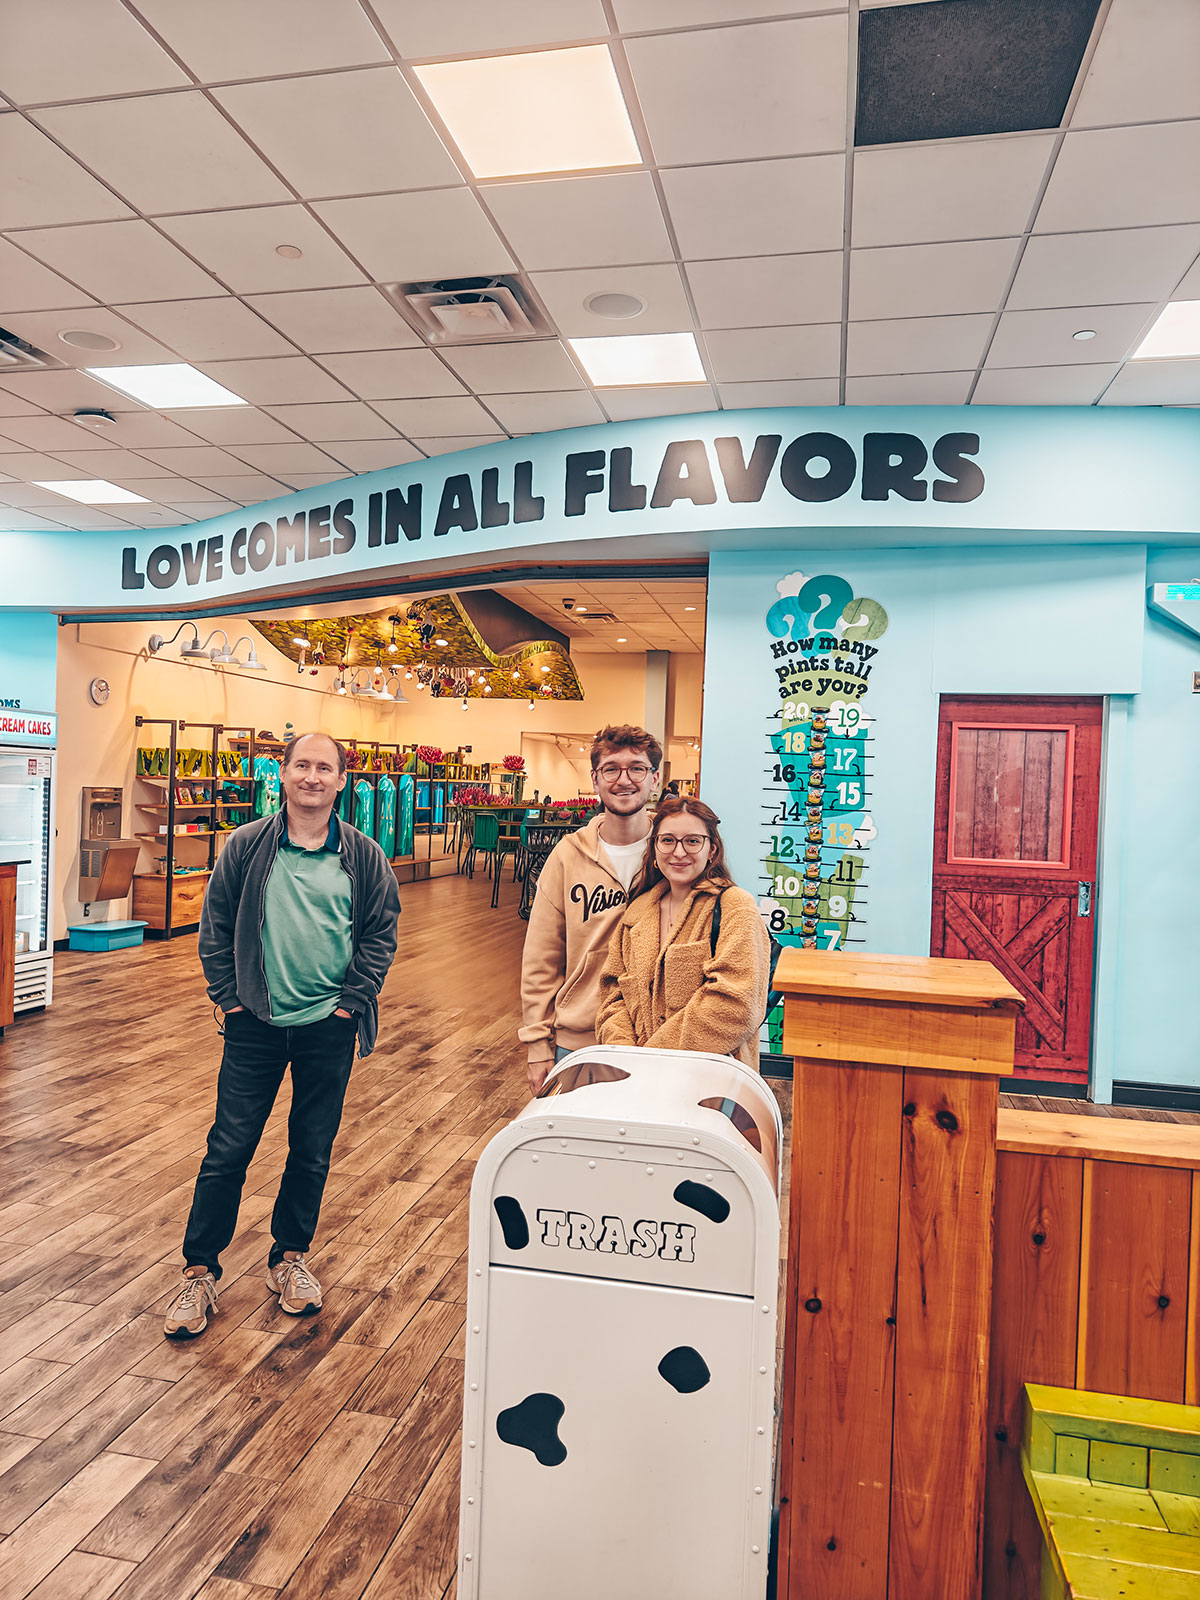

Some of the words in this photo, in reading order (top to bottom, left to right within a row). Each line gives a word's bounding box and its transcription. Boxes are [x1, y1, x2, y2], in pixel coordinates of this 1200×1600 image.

[121, 534, 224, 590] LOVE
[230, 498, 357, 576] COMES
[367, 482, 423, 549] IN
[433, 460, 546, 537] ALL
[563, 431, 986, 518] FLAVORS
[769, 637, 815, 659] How
[818, 636, 879, 661] many
[775, 655, 829, 684] pints
[834, 656, 872, 681] tall
[778, 678, 813, 699] are
[815, 677, 868, 699] you?
[783, 701, 810, 719] 20
[837, 708, 860, 728] 19
[27, 720, 52, 736] CAKES
[781, 731, 806, 753] 18
[833, 748, 858, 771] 17
[772, 764, 796, 782] 16
[836, 782, 861, 805] 15
[779, 801, 802, 821] 14
[827, 823, 854, 846] 13
[770, 835, 794, 857] 12
[836, 860, 856, 882] 11
[774, 875, 800, 896] 10
[828, 895, 848, 917] 9
[769, 909, 786, 932] 8
[536, 1208, 697, 1263] TRASH
